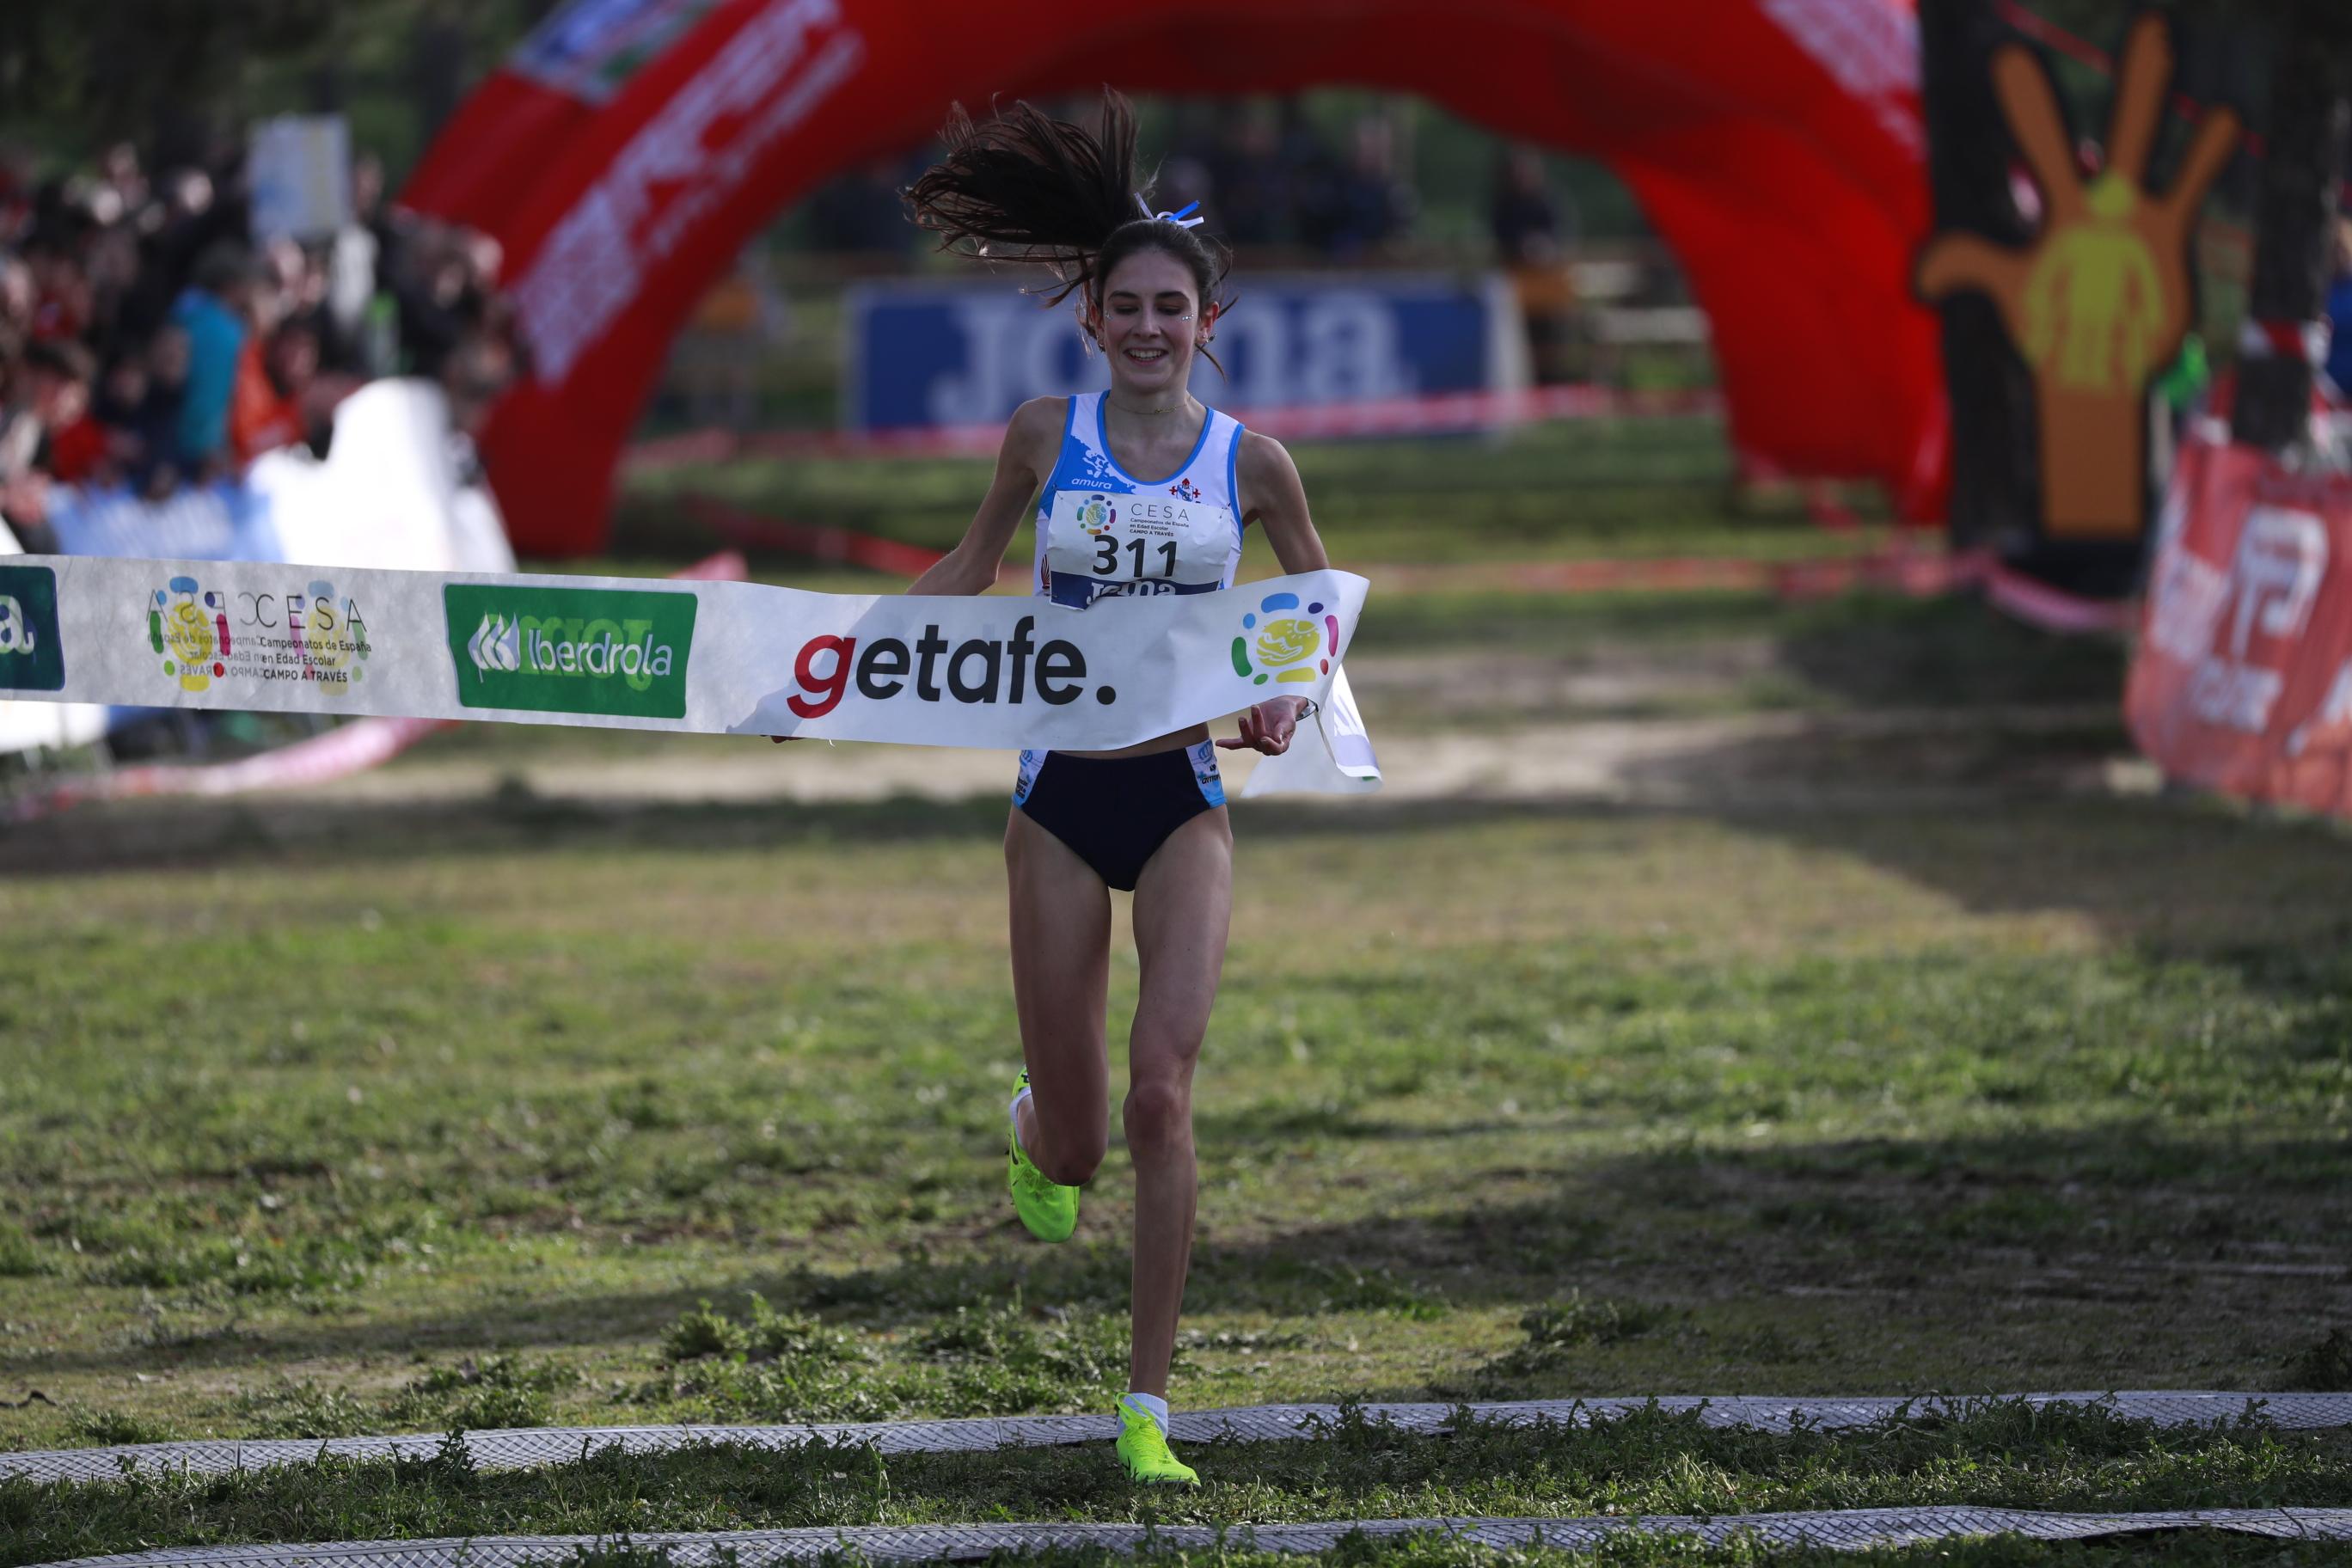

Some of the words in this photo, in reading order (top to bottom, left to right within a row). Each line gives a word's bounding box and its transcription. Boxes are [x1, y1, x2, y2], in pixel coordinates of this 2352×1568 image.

[1071, 478, 1112, 489] amura
[1130, 503, 1189, 521] CESA
[1130, 518, 1164, 526] Campeonatos
[1093, 535, 1177, 578] 311
[256, 593, 367, 633] CESA
[260, 636, 323, 650] Campeonatos
[326, 640, 337, 650] de
[339, 640, 372, 652] España
[528, 629, 673, 676] Iberdrola
[261, 654, 273, 663] en
[276, 653, 300, 665] Edad
[303, 654, 335, 666] Escolar
[786, 615, 1118, 720] getafe.
[263, 669, 298, 680] CAMPO
[301, 671, 308, 680] A
[310, 670, 348, 683] TRAVÉS
